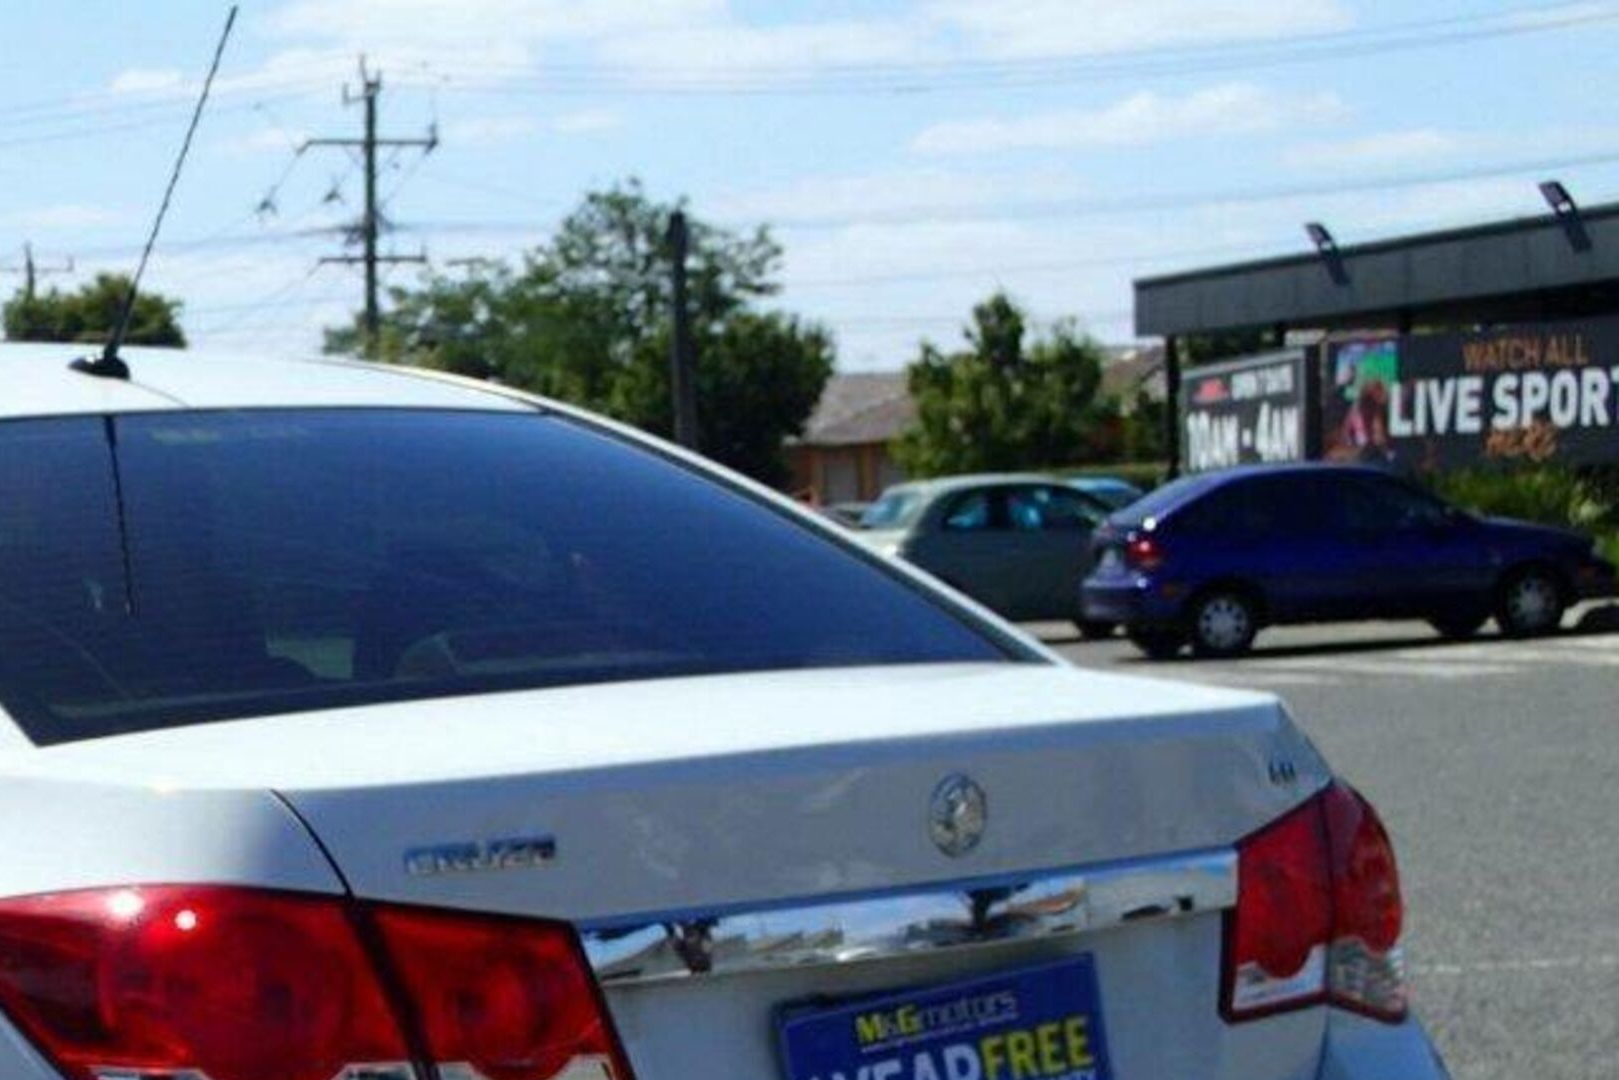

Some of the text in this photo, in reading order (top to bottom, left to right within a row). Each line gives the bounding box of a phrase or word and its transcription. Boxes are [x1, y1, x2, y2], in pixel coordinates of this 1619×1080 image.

[1463, 333, 1589, 371] WATCH ALL
[1389, 366, 1619, 437] LIVE SPOR
